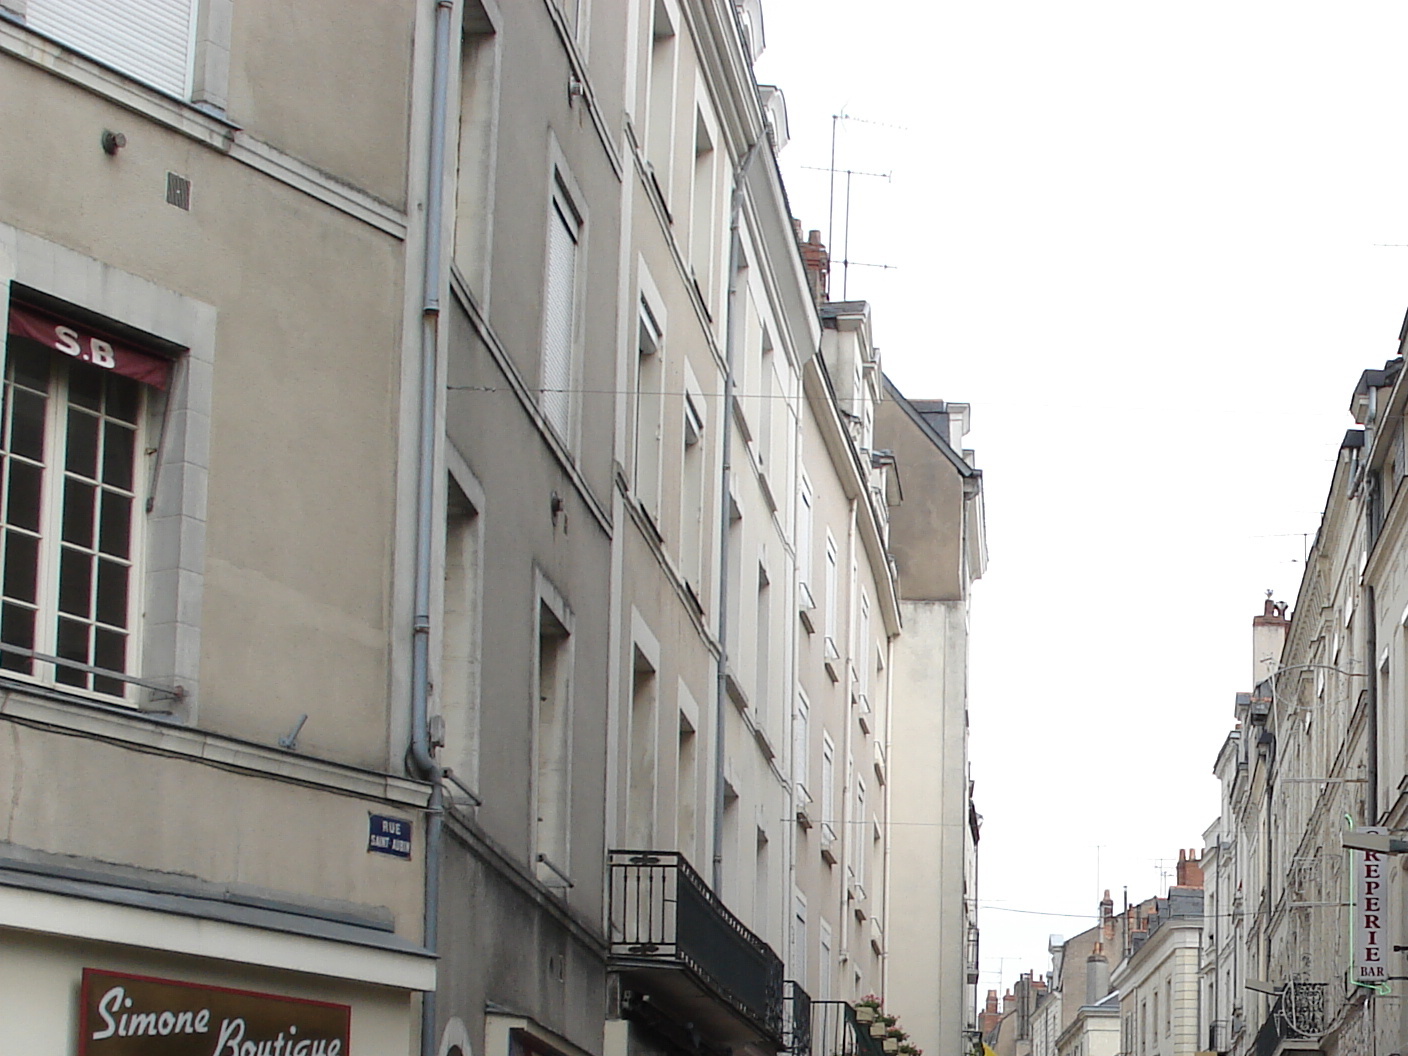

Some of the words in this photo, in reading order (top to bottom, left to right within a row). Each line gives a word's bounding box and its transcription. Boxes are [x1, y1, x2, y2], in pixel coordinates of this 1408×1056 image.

[55, 325, 115, 369] S.B
[382, 820, 401, 835] RUE
[1364, 831, 1381, 962] REPERIE
[1360, 966, 1385, 977] BAR
[92, 986, 211, 1040] Simone
